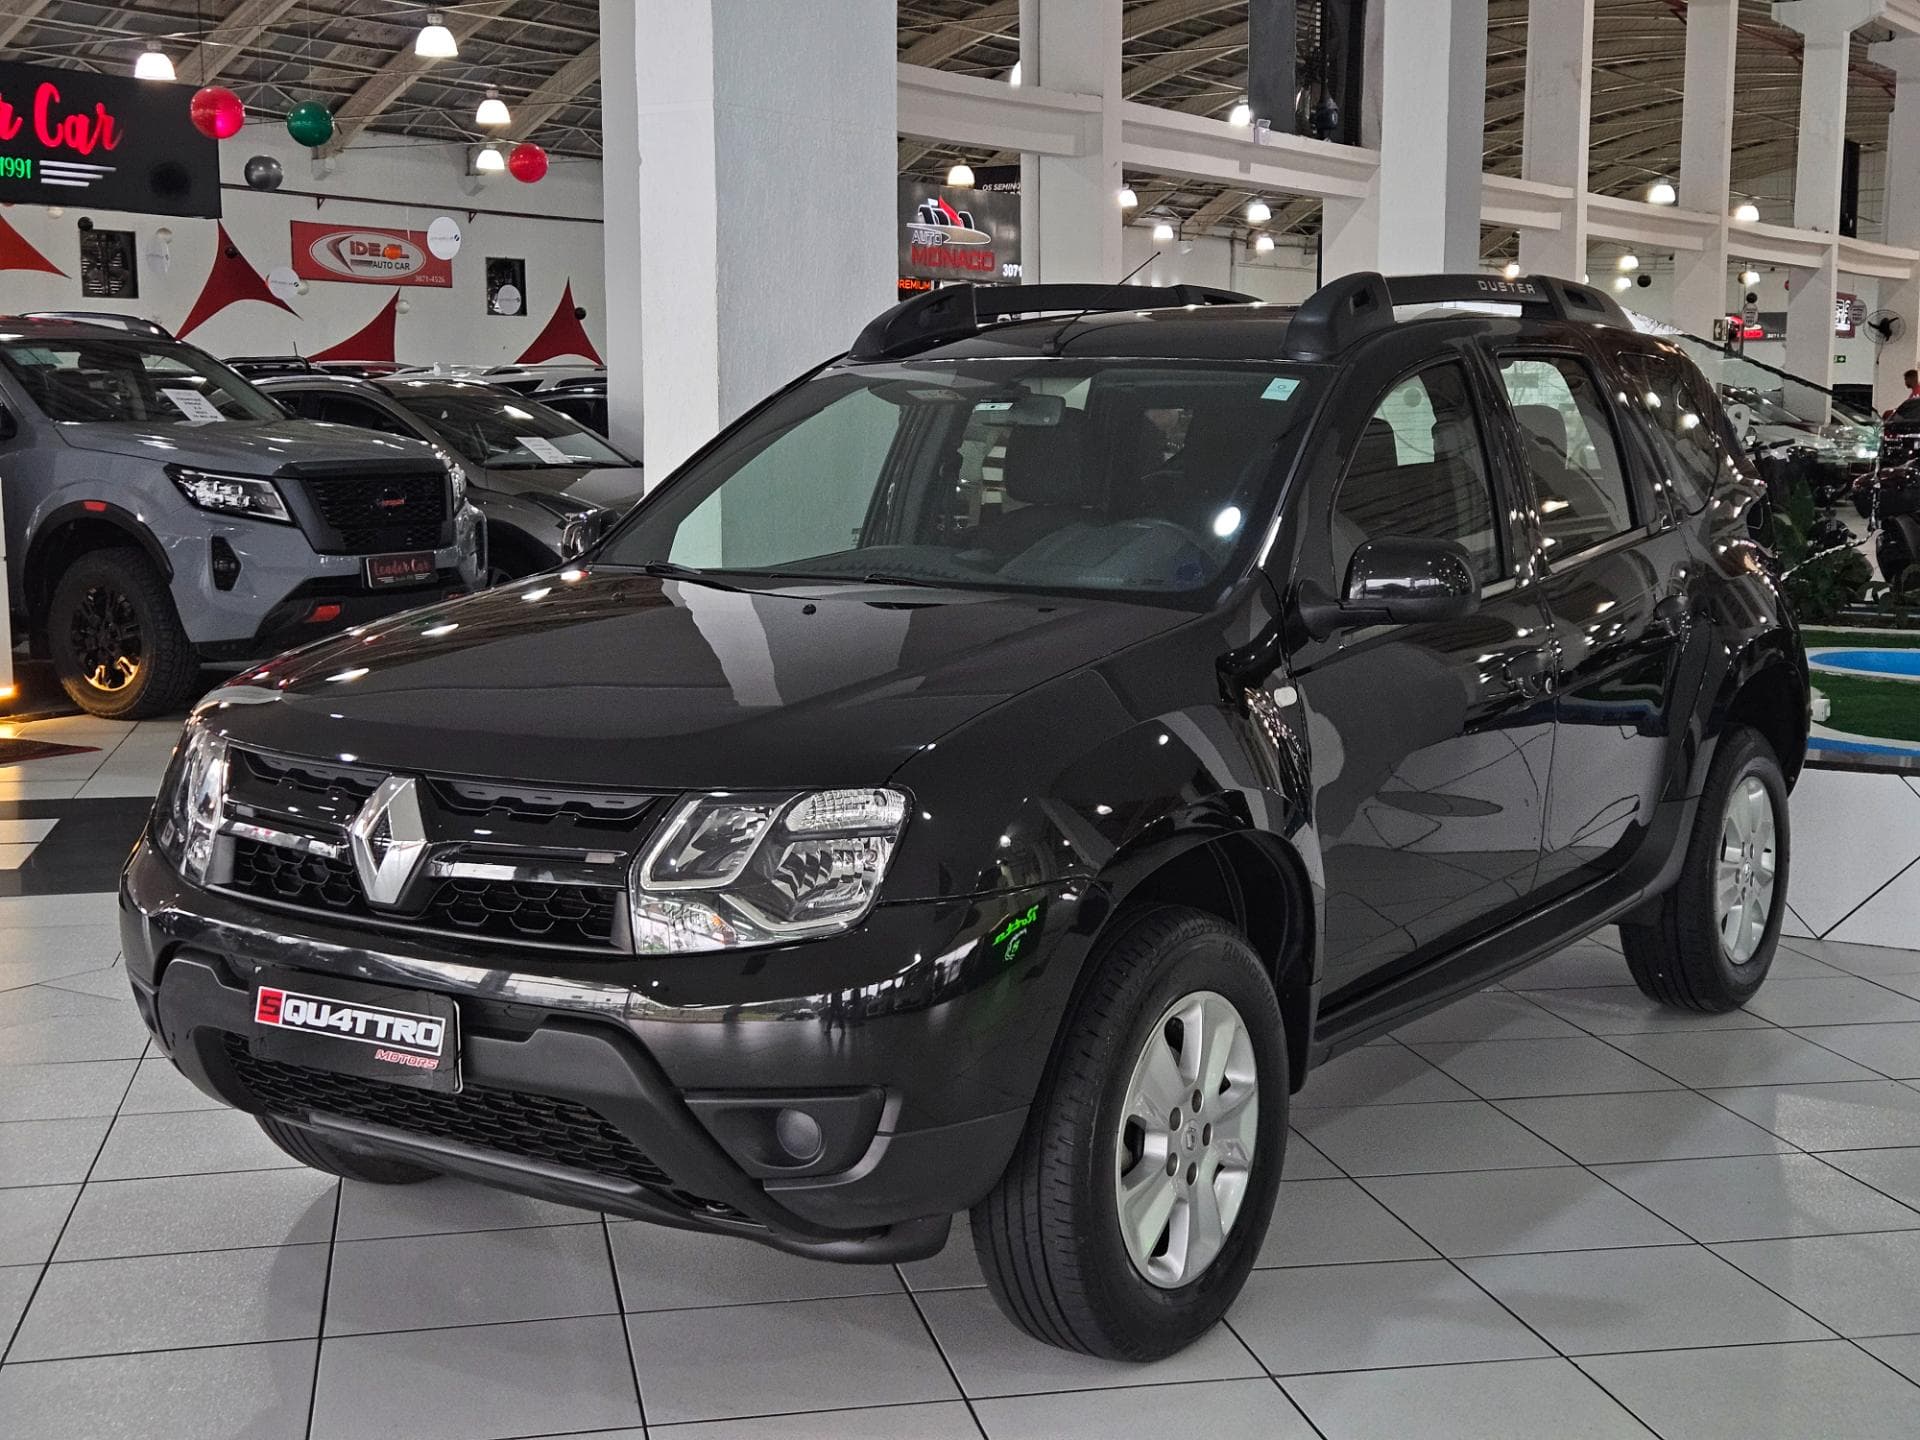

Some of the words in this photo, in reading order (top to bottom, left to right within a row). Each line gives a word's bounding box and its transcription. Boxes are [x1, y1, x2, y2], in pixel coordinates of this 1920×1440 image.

[34, 82, 123, 155] Car
[0, 157, 31, 179] 1991
[912, 230, 943, 245] AUTO
[372, 260, 393, 270] AUTO
[394, 262, 410, 271] CAR
[911, 245, 995, 272] MONACO
[1477, 280, 1536, 295] DUSTER
[375, 1048, 439, 1070] MOTORS
